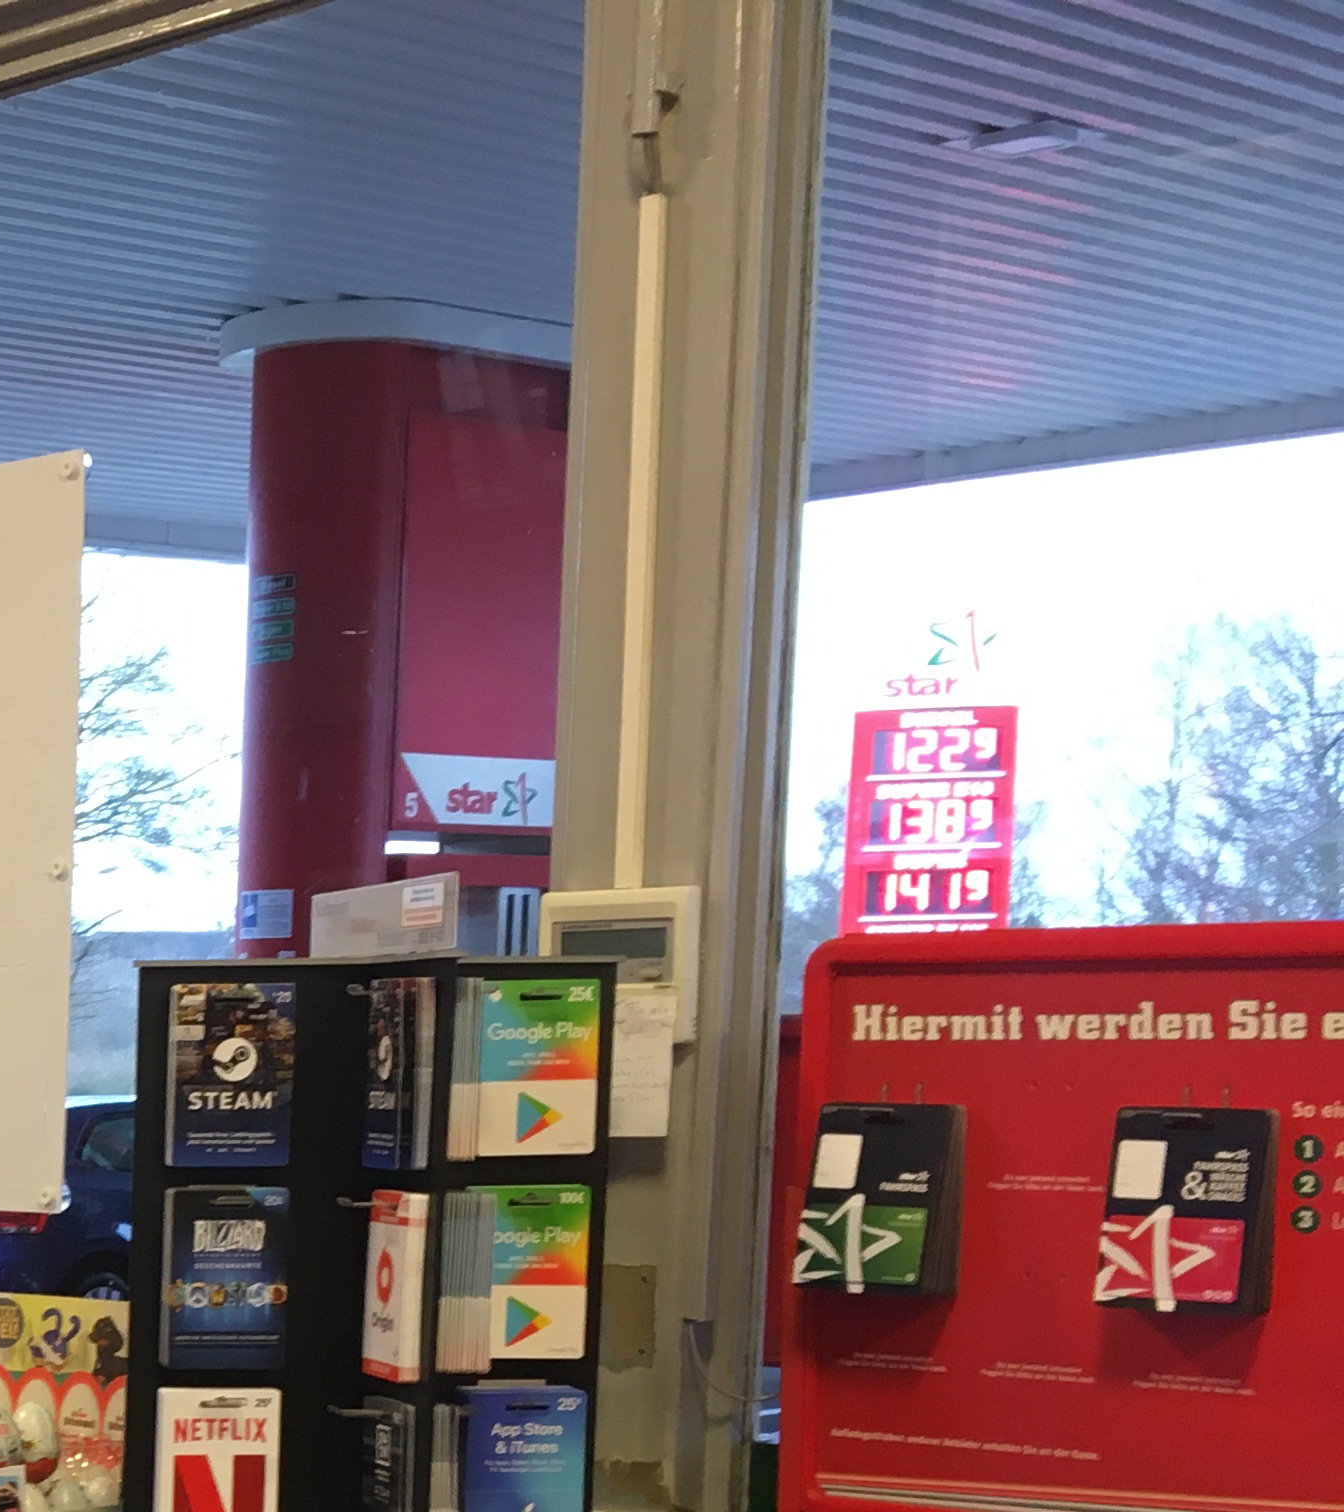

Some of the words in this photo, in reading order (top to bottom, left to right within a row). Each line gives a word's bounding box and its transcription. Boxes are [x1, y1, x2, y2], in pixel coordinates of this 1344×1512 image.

[884, 674, 958, 697] star
[446, 781, 498, 815] star
[487, 1021, 552, 1044] Google
[554, 1022, 592, 1043] Play
[852, 1003, 1025, 1043] Hiermit
[1036, 1001, 1214, 1042] werden
[1228, 1000, 1308, 1041] Sie
[187, 1091, 274, 1110] STEAM
[192, 1220, 267, 1254] BLIZZARD
[544, 1226, 582, 1245] Play
[172, 1417, 267, 1443] NETFLIX
[491, 1421, 521, 1439] App
[524, 1421, 564, 1437] Store
[495, 1440, 507, 1455] &
[510, 1440, 558, 1455] iTunes
